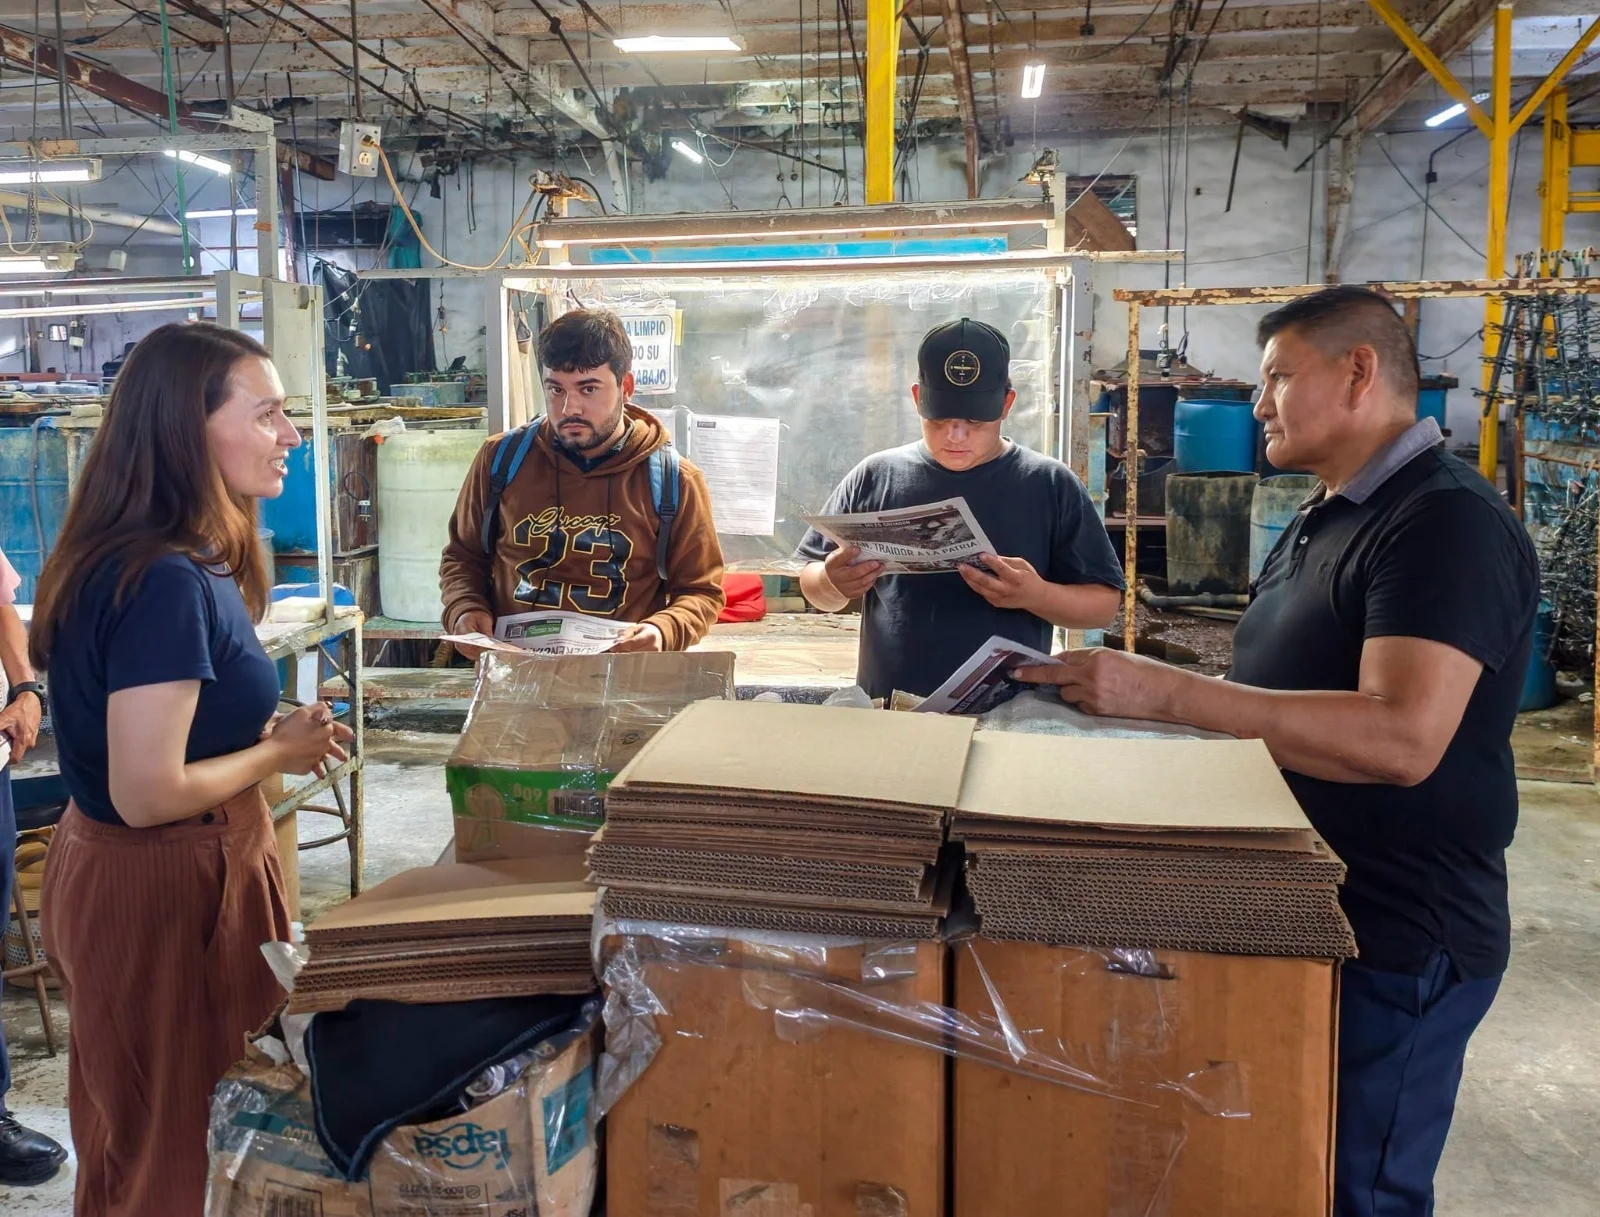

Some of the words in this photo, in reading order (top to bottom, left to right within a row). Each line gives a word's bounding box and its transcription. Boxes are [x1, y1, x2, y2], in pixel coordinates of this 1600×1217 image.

[634, 320, 666, 336] LIMPIO
[647, 344, 659, 360] SU
[632, 368, 667, 385] ABAJO
[874, 543, 915, 557] TRAIDOR
[942, 541, 978, 554] PATRIA
[513, 527, 634, 615] 23
